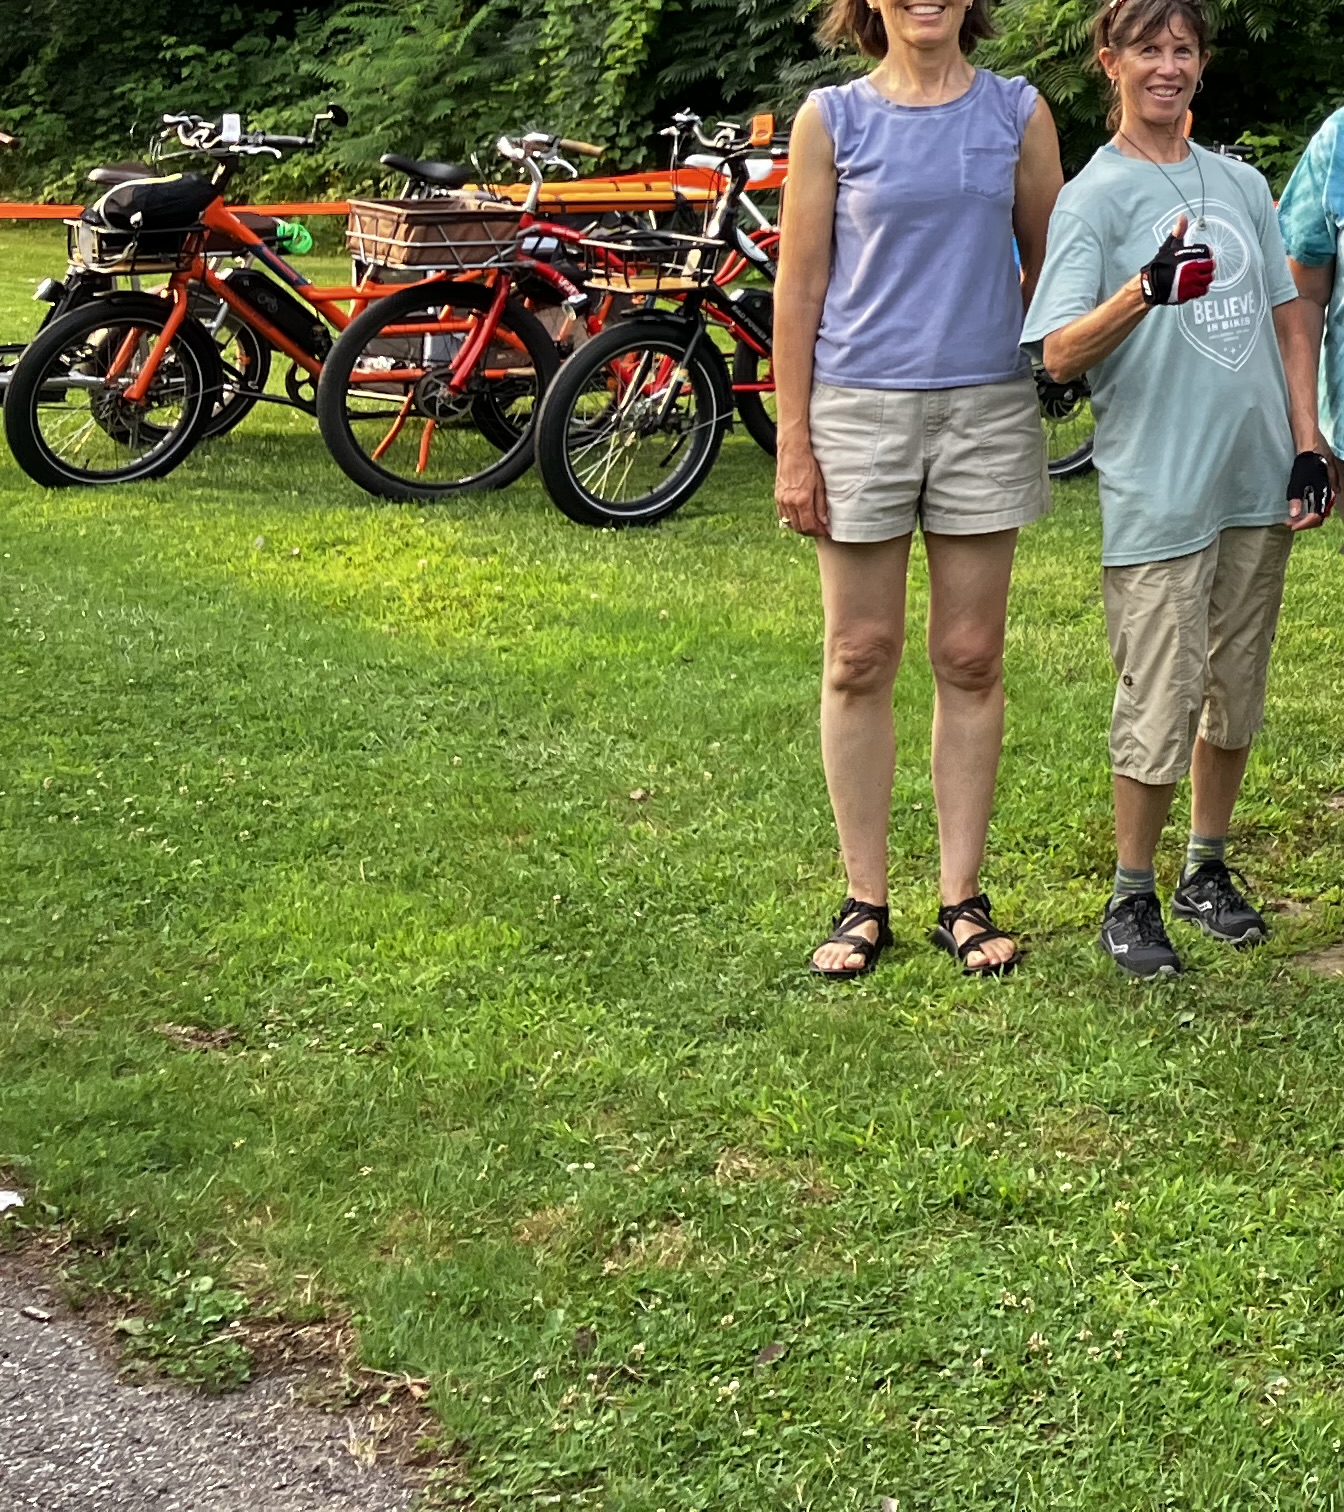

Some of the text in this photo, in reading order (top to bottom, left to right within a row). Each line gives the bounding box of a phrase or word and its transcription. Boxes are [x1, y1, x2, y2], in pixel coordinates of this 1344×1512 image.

[1193, 290, 1256, 325] BELIEVE
[1206, 316, 1251, 333] IN BIKES
